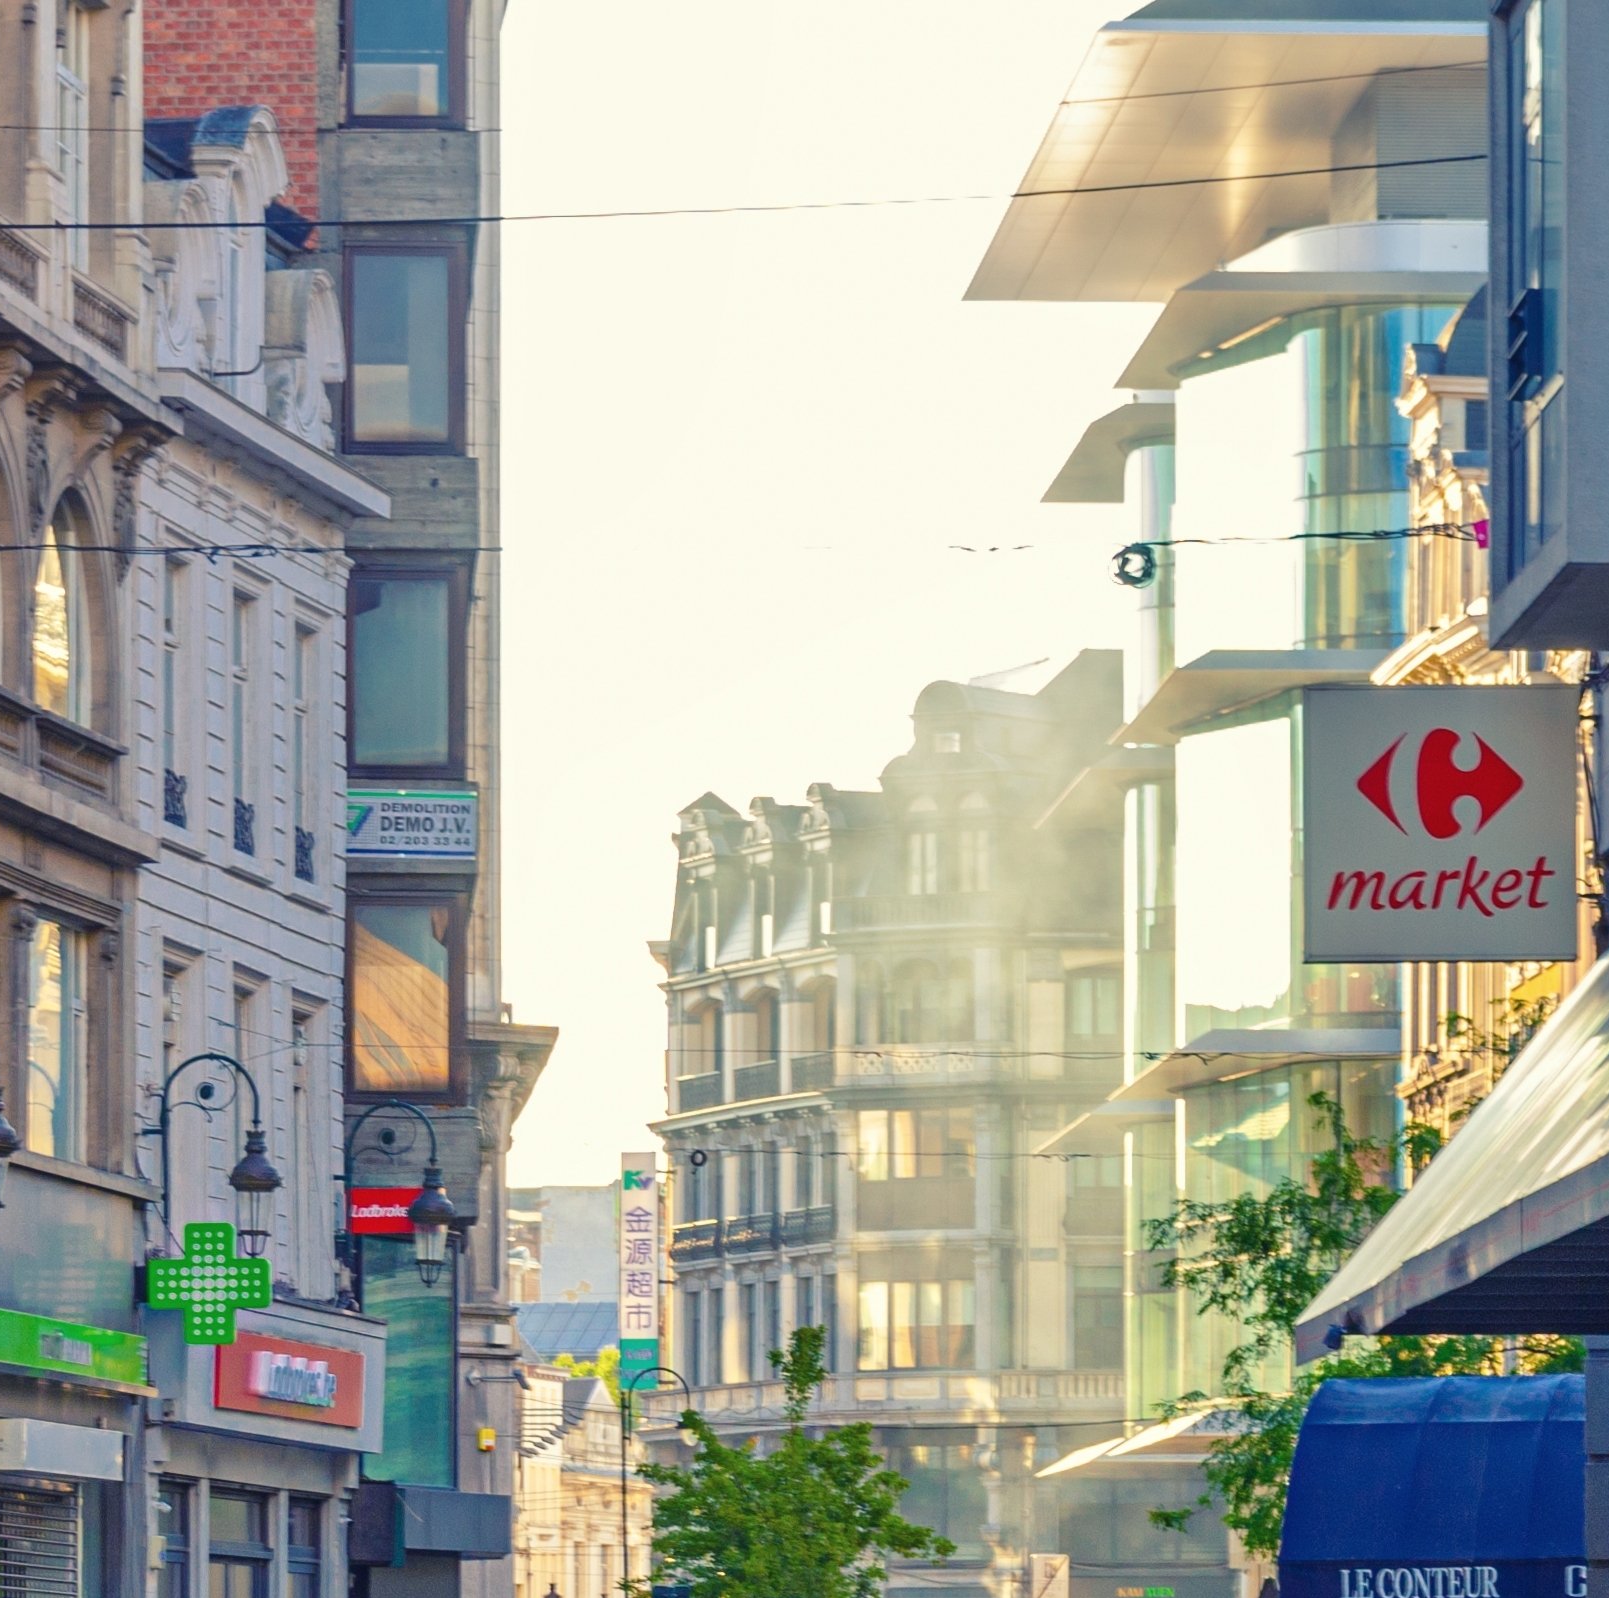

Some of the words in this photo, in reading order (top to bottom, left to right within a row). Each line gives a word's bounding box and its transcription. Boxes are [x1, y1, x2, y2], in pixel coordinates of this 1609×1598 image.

[380, 802, 471, 815] DEMOLITION
[380, 816, 434, 833] DEMO
[439, 817, 471, 834] J.V.
[1325, 855, 1556, 919] market
[351, 1203, 409, 1218] Ladbroke
[625, 1206, 654, 1331] 金源超市
